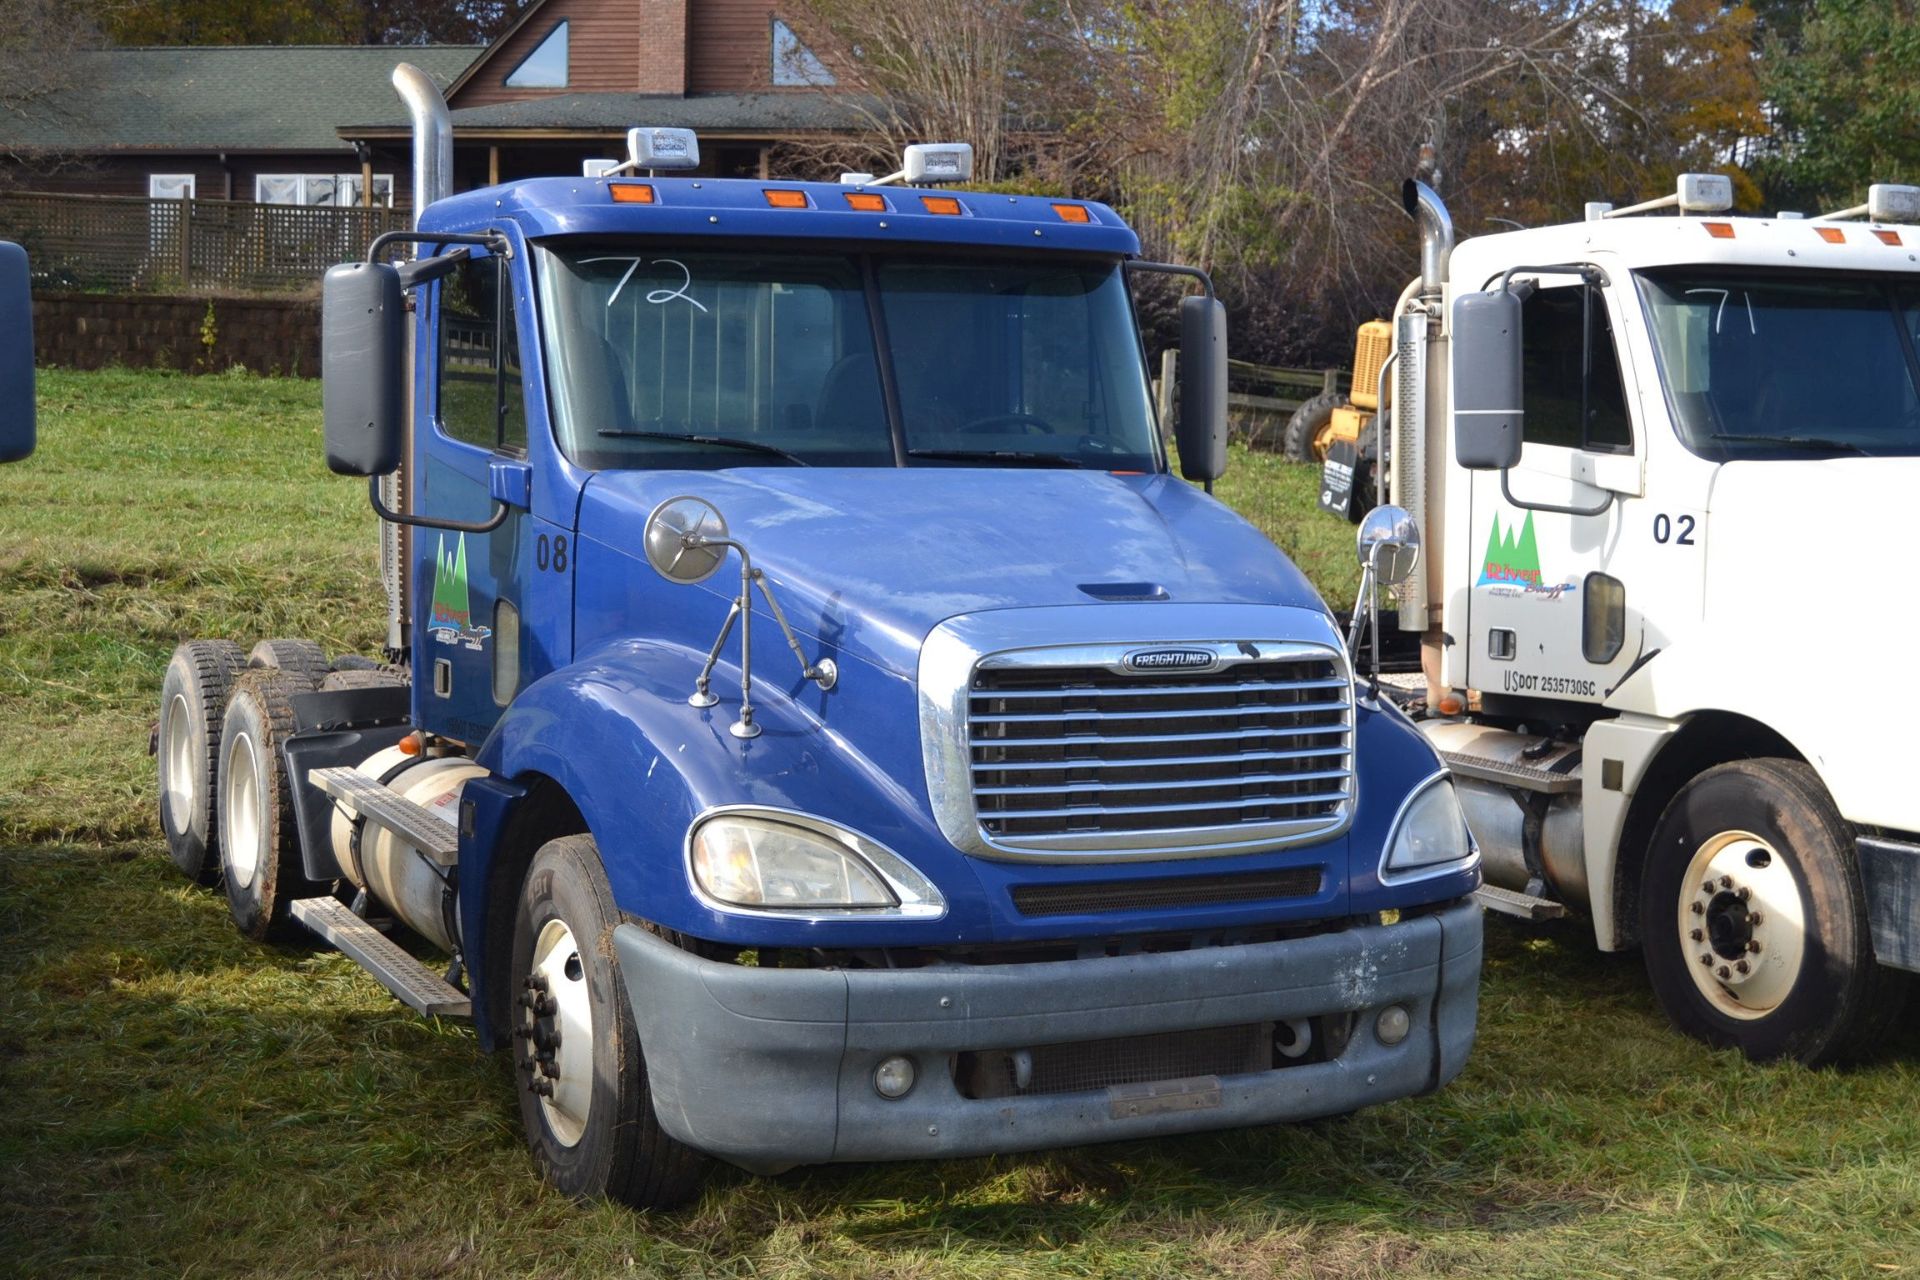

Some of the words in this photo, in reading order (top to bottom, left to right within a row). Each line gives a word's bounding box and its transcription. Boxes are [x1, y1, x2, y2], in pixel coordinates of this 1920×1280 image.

[576, 256, 709, 313] 72
[1684, 288, 1756, 335] 71
[1653, 513, 1696, 546] 02
[536, 533, 567, 573] 08
[1486, 562, 1541, 584] River
[1135, 653, 1209, 667] FREIGHTLINER
[1503, 669, 1538, 692] USDOT
[1541, 676, 1597, 697] 2535730SC
